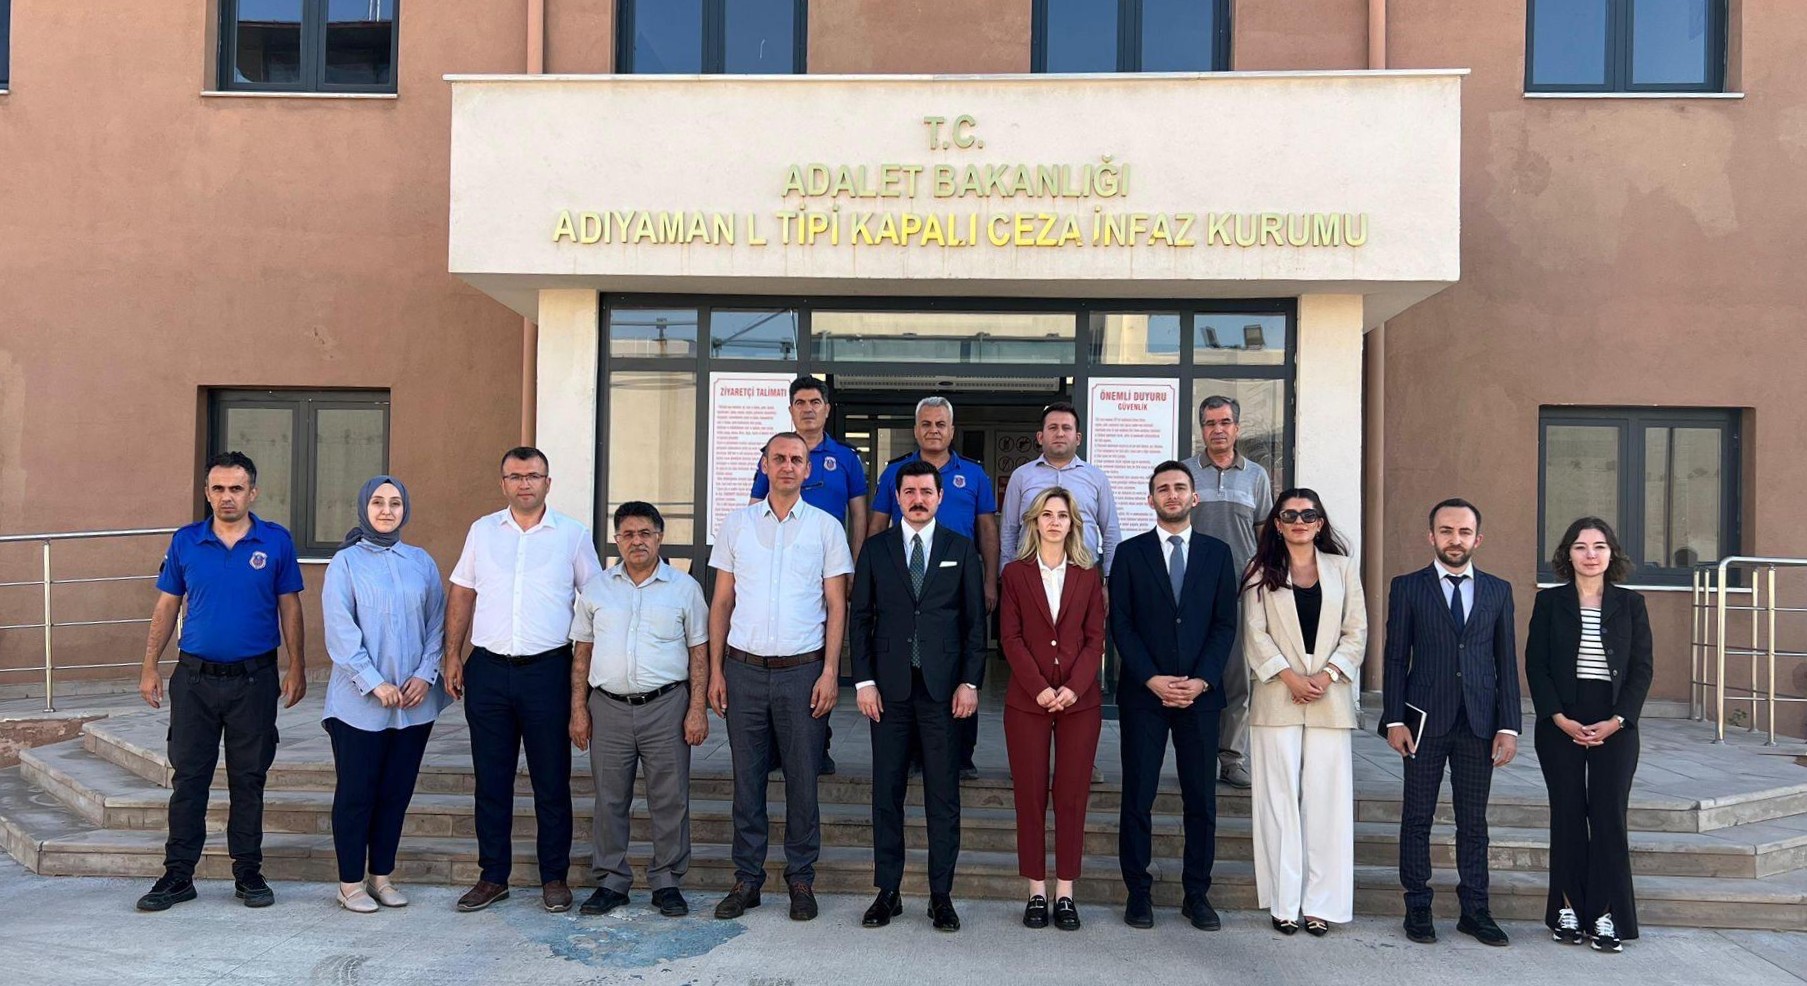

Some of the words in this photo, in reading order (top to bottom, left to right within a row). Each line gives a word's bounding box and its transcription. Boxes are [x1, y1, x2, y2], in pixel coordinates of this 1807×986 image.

[924, 114, 986, 150] T.C.
[781, 163, 923, 199] ADALET
[932, 153, 1131, 199] BAKANLIĞI
[552, 209, 736, 246] ADIYAMAN
[748, 212, 768, 246] L
[776, 203, 840, 247] TİPİ
[851, 211, 978, 247] KAPALI
[986, 211, 1083, 248] CEZA
[1092, 205, 1197, 248] İNFAZ
[1207, 212, 1370, 248] KURUMU
[720, 386, 755, 399] ZİYARETÇİ
[756, 386, 787, 397] TALİMATI
[1100, 389, 1131, 401] ÖNEMLİ
[1133, 391, 1167, 402] DUYURU
[1117, 402, 1148, 411] GÜVENLİK
